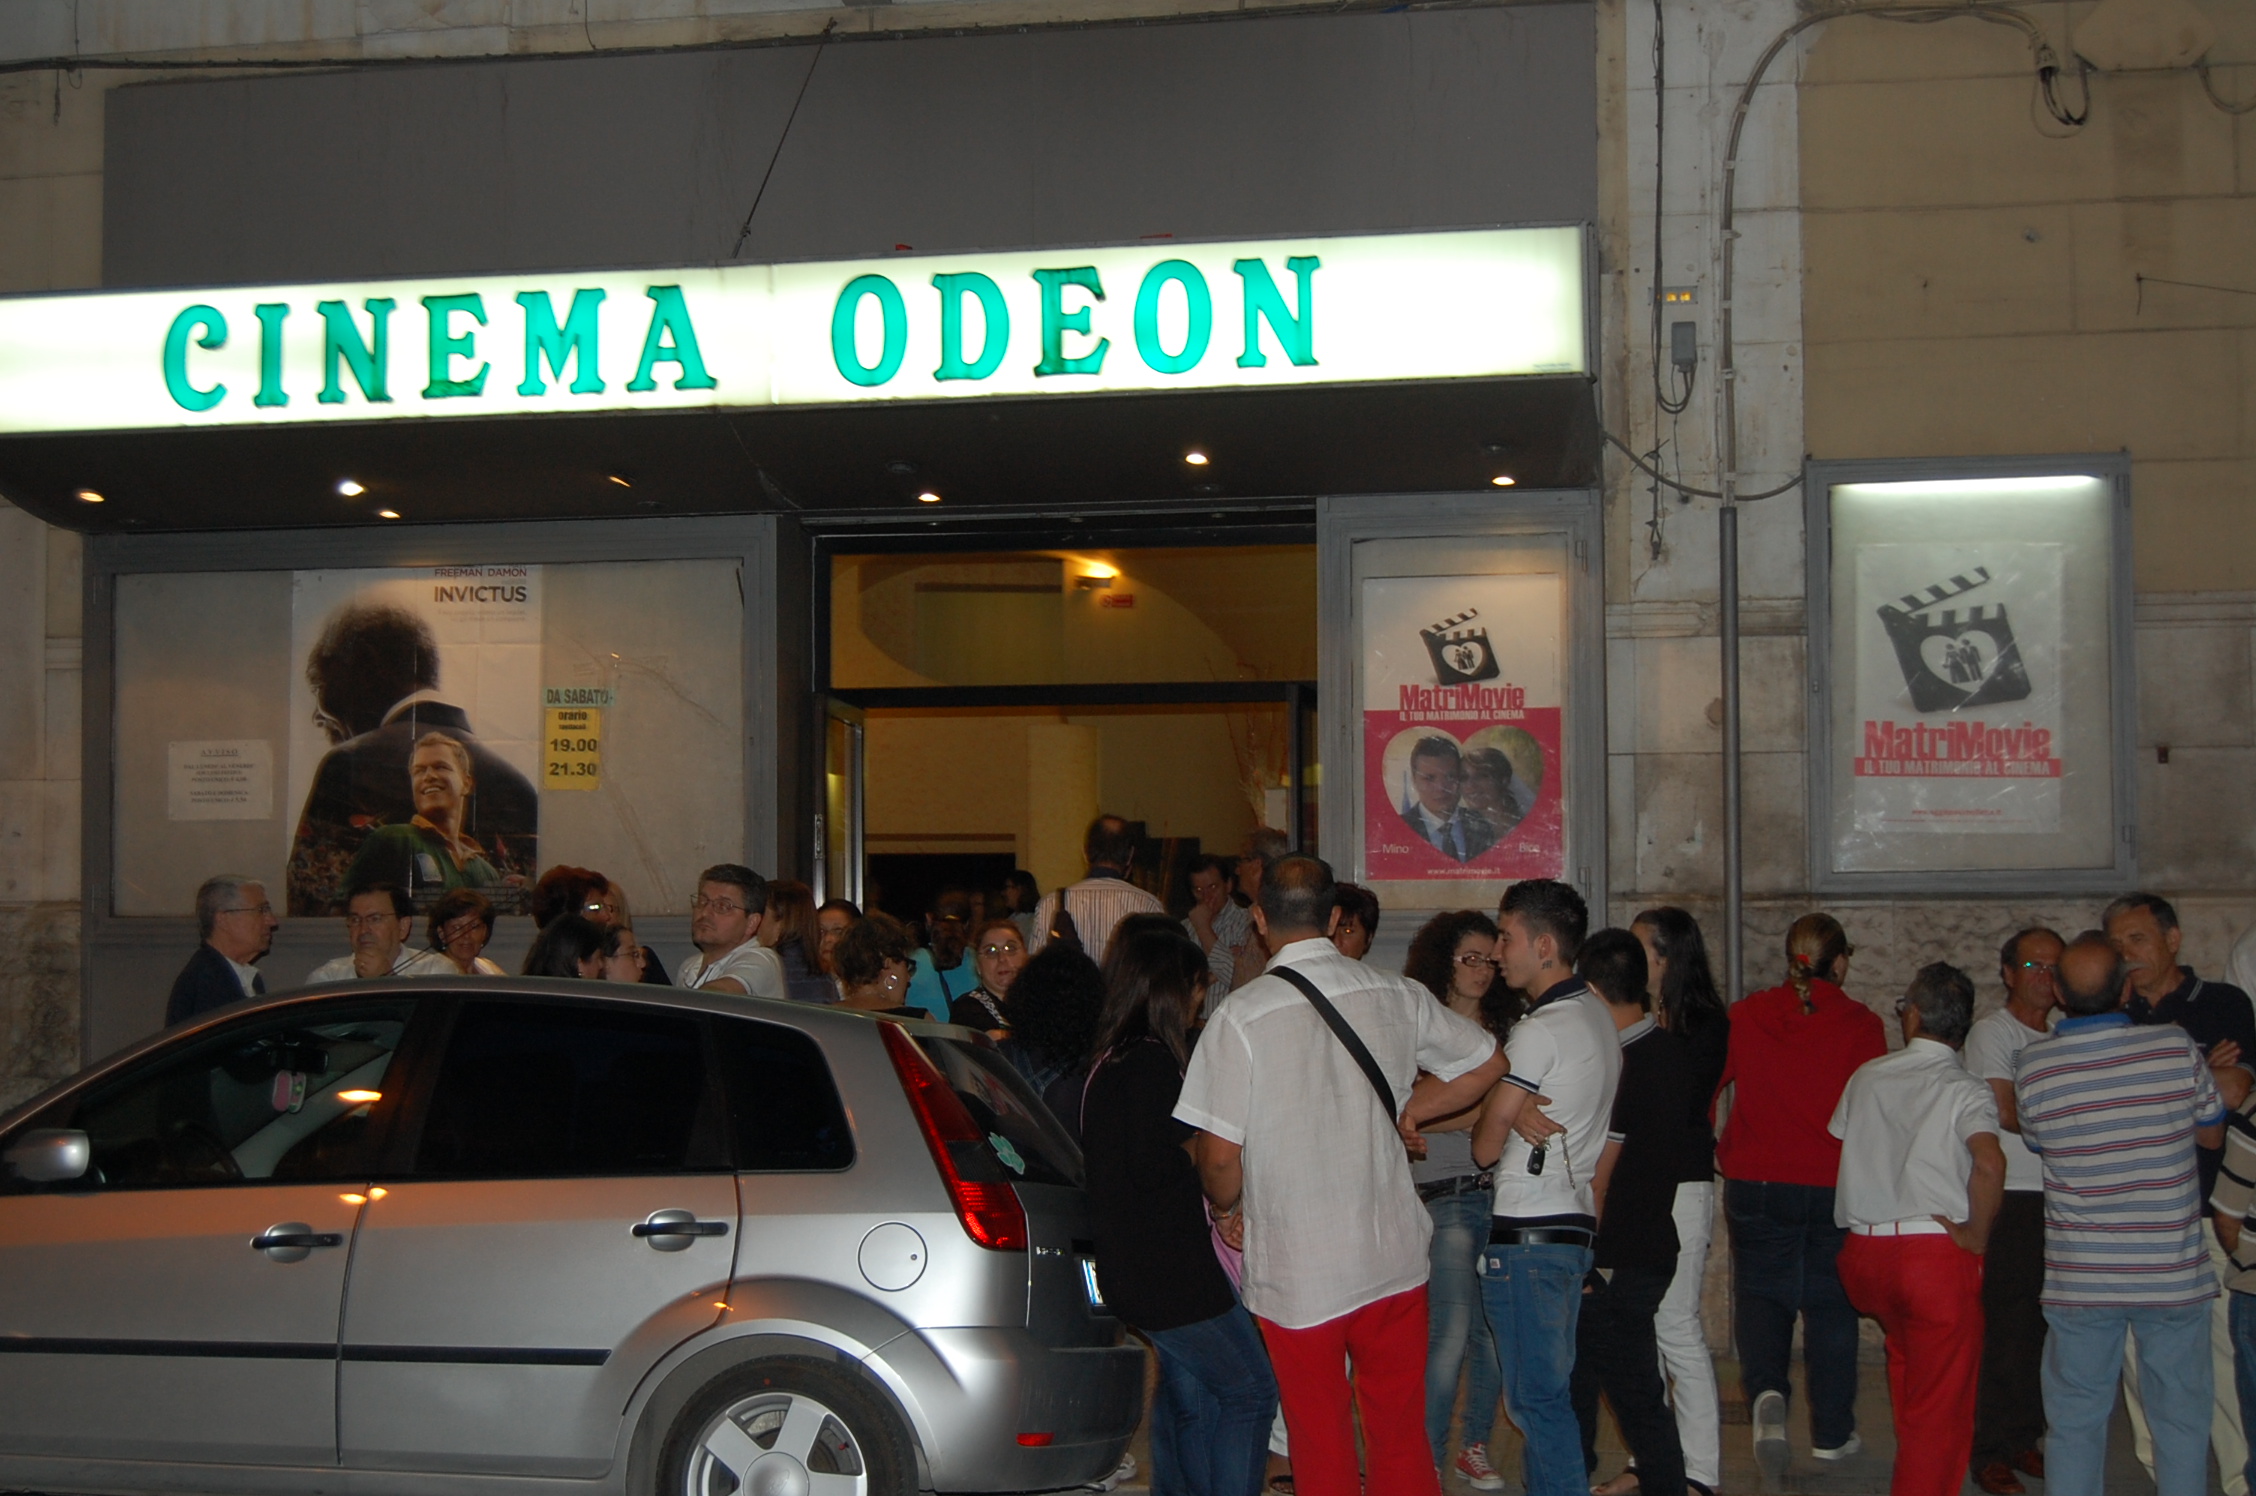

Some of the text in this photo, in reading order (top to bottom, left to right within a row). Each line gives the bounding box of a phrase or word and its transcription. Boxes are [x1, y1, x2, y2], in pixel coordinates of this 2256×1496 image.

[164, 256, 1320, 411] CINEMA ODEON
[434, 568, 528, 578] FREEMAN DAMON
[434, 585, 528, 603] INVICTUS
[546, 688, 561, 704] DA
[1399, 683, 1525, 710] MatriMovie
[558, 711, 588, 720] orario
[1400, 709, 1525, 720] IL TUO MATRIMONIO AL CINEMA
[550, 738, 598, 752] 19.00
[1864, 721, 2052, 759] MatriMovie
[549, 762, 598, 776] 21.30
[1864, 760, 2051, 775] IL TUO MATRIMONIO AL CINEMA
[1382, 844, 1410, 854] Mino
